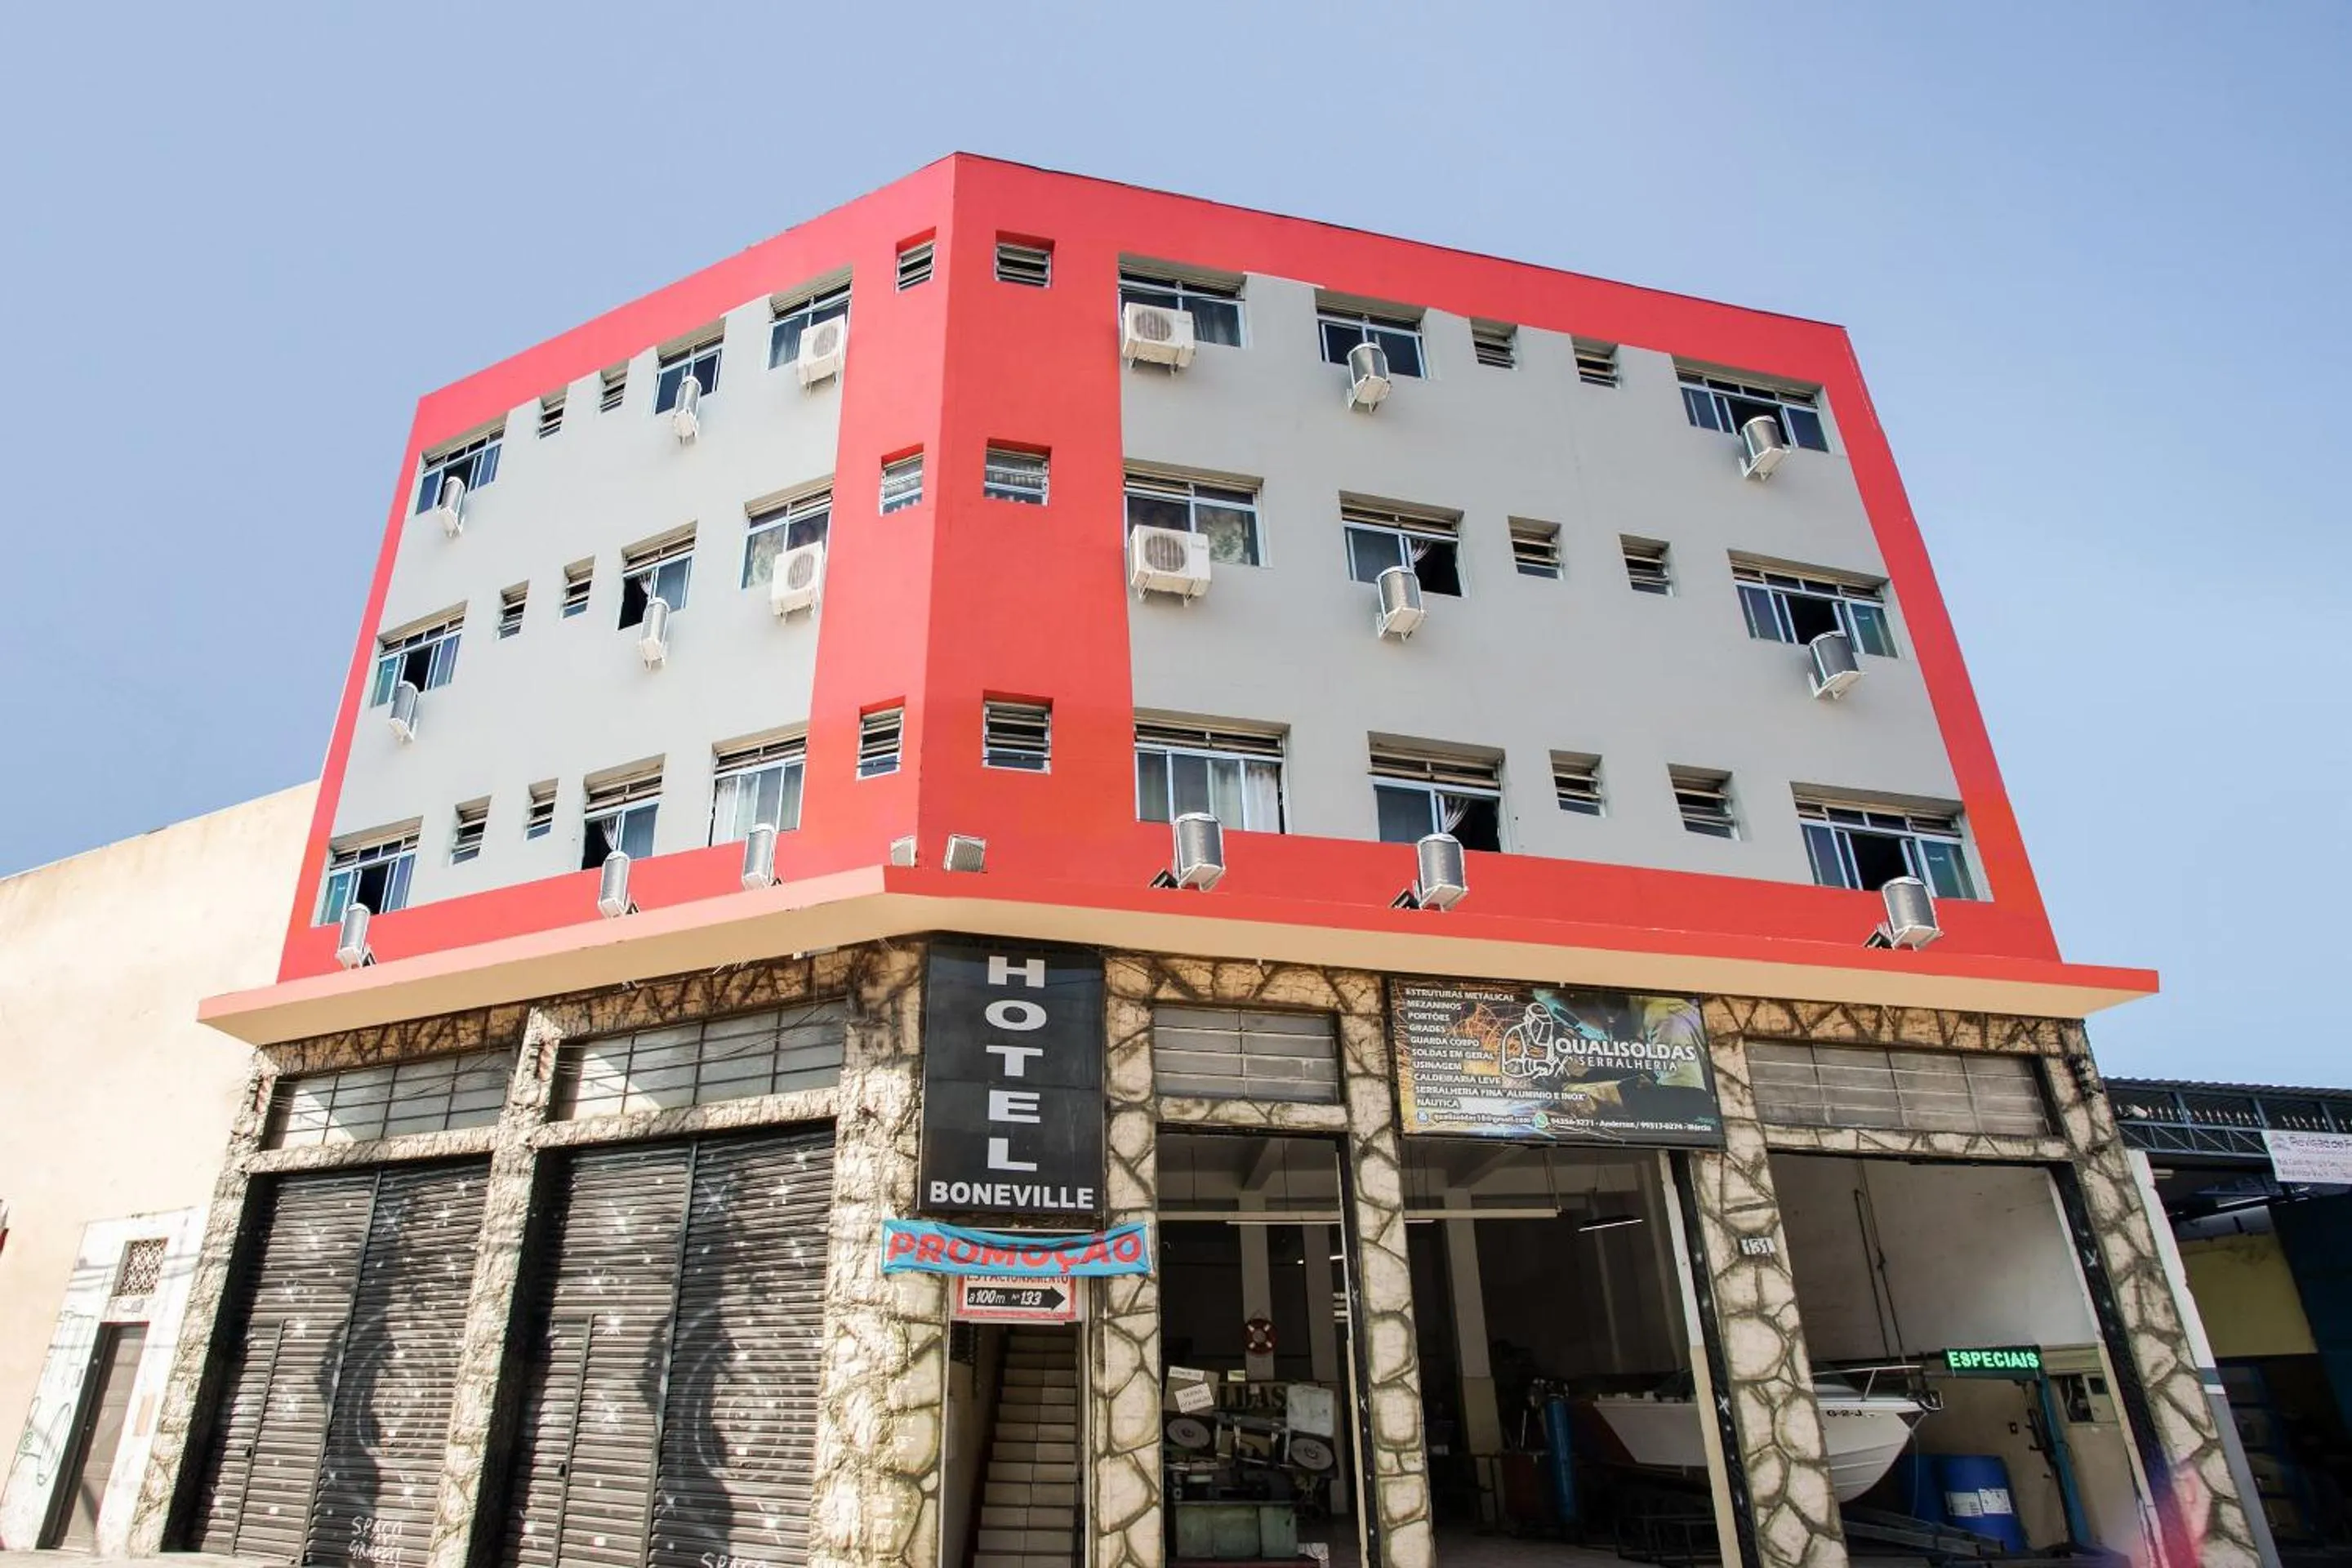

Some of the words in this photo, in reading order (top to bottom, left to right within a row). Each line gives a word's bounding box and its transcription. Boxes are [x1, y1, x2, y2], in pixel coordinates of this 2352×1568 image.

[1405, 988, 1463, 998] ESTRUTURAS
[1406, 1000, 1462, 1010] MEZANINOS
[1409, 1024, 1446, 1033] GRADES
[1410, 1036, 1447, 1045] GUARDA
[1450, 1038, 1480, 1047] CORPO
[1555, 1037, 1696, 1060] QUALISOLDAS
[1412, 1049, 1447, 1058] SOLDAS
[1450, 1050, 1463, 1058] EM
[1464, 1051, 1494, 1060] GERAL
[986, 956, 1047, 1172] HOTEL
[1414, 1062, 1462, 1071] USINAGEM
[1579, 1056, 1677, 1071] SERRALHERIA
[1414, 1073, 1477, 1084] CALDEIRARIA
[1478, 1076, 1501, 1085] LEVE
[1415, 1086, 1479, 1096] SERRALHERIA
[1553, 1092, 1560, 1100] E
[929, 1181, 1094, 1209] BONEVILLE
[886, 1230, 1142, 1273] PROMOÇÃO
[1021, 1290, 1042, 1305] 133
[1947, 1351, 2039, 1369] ESPECIAIS
